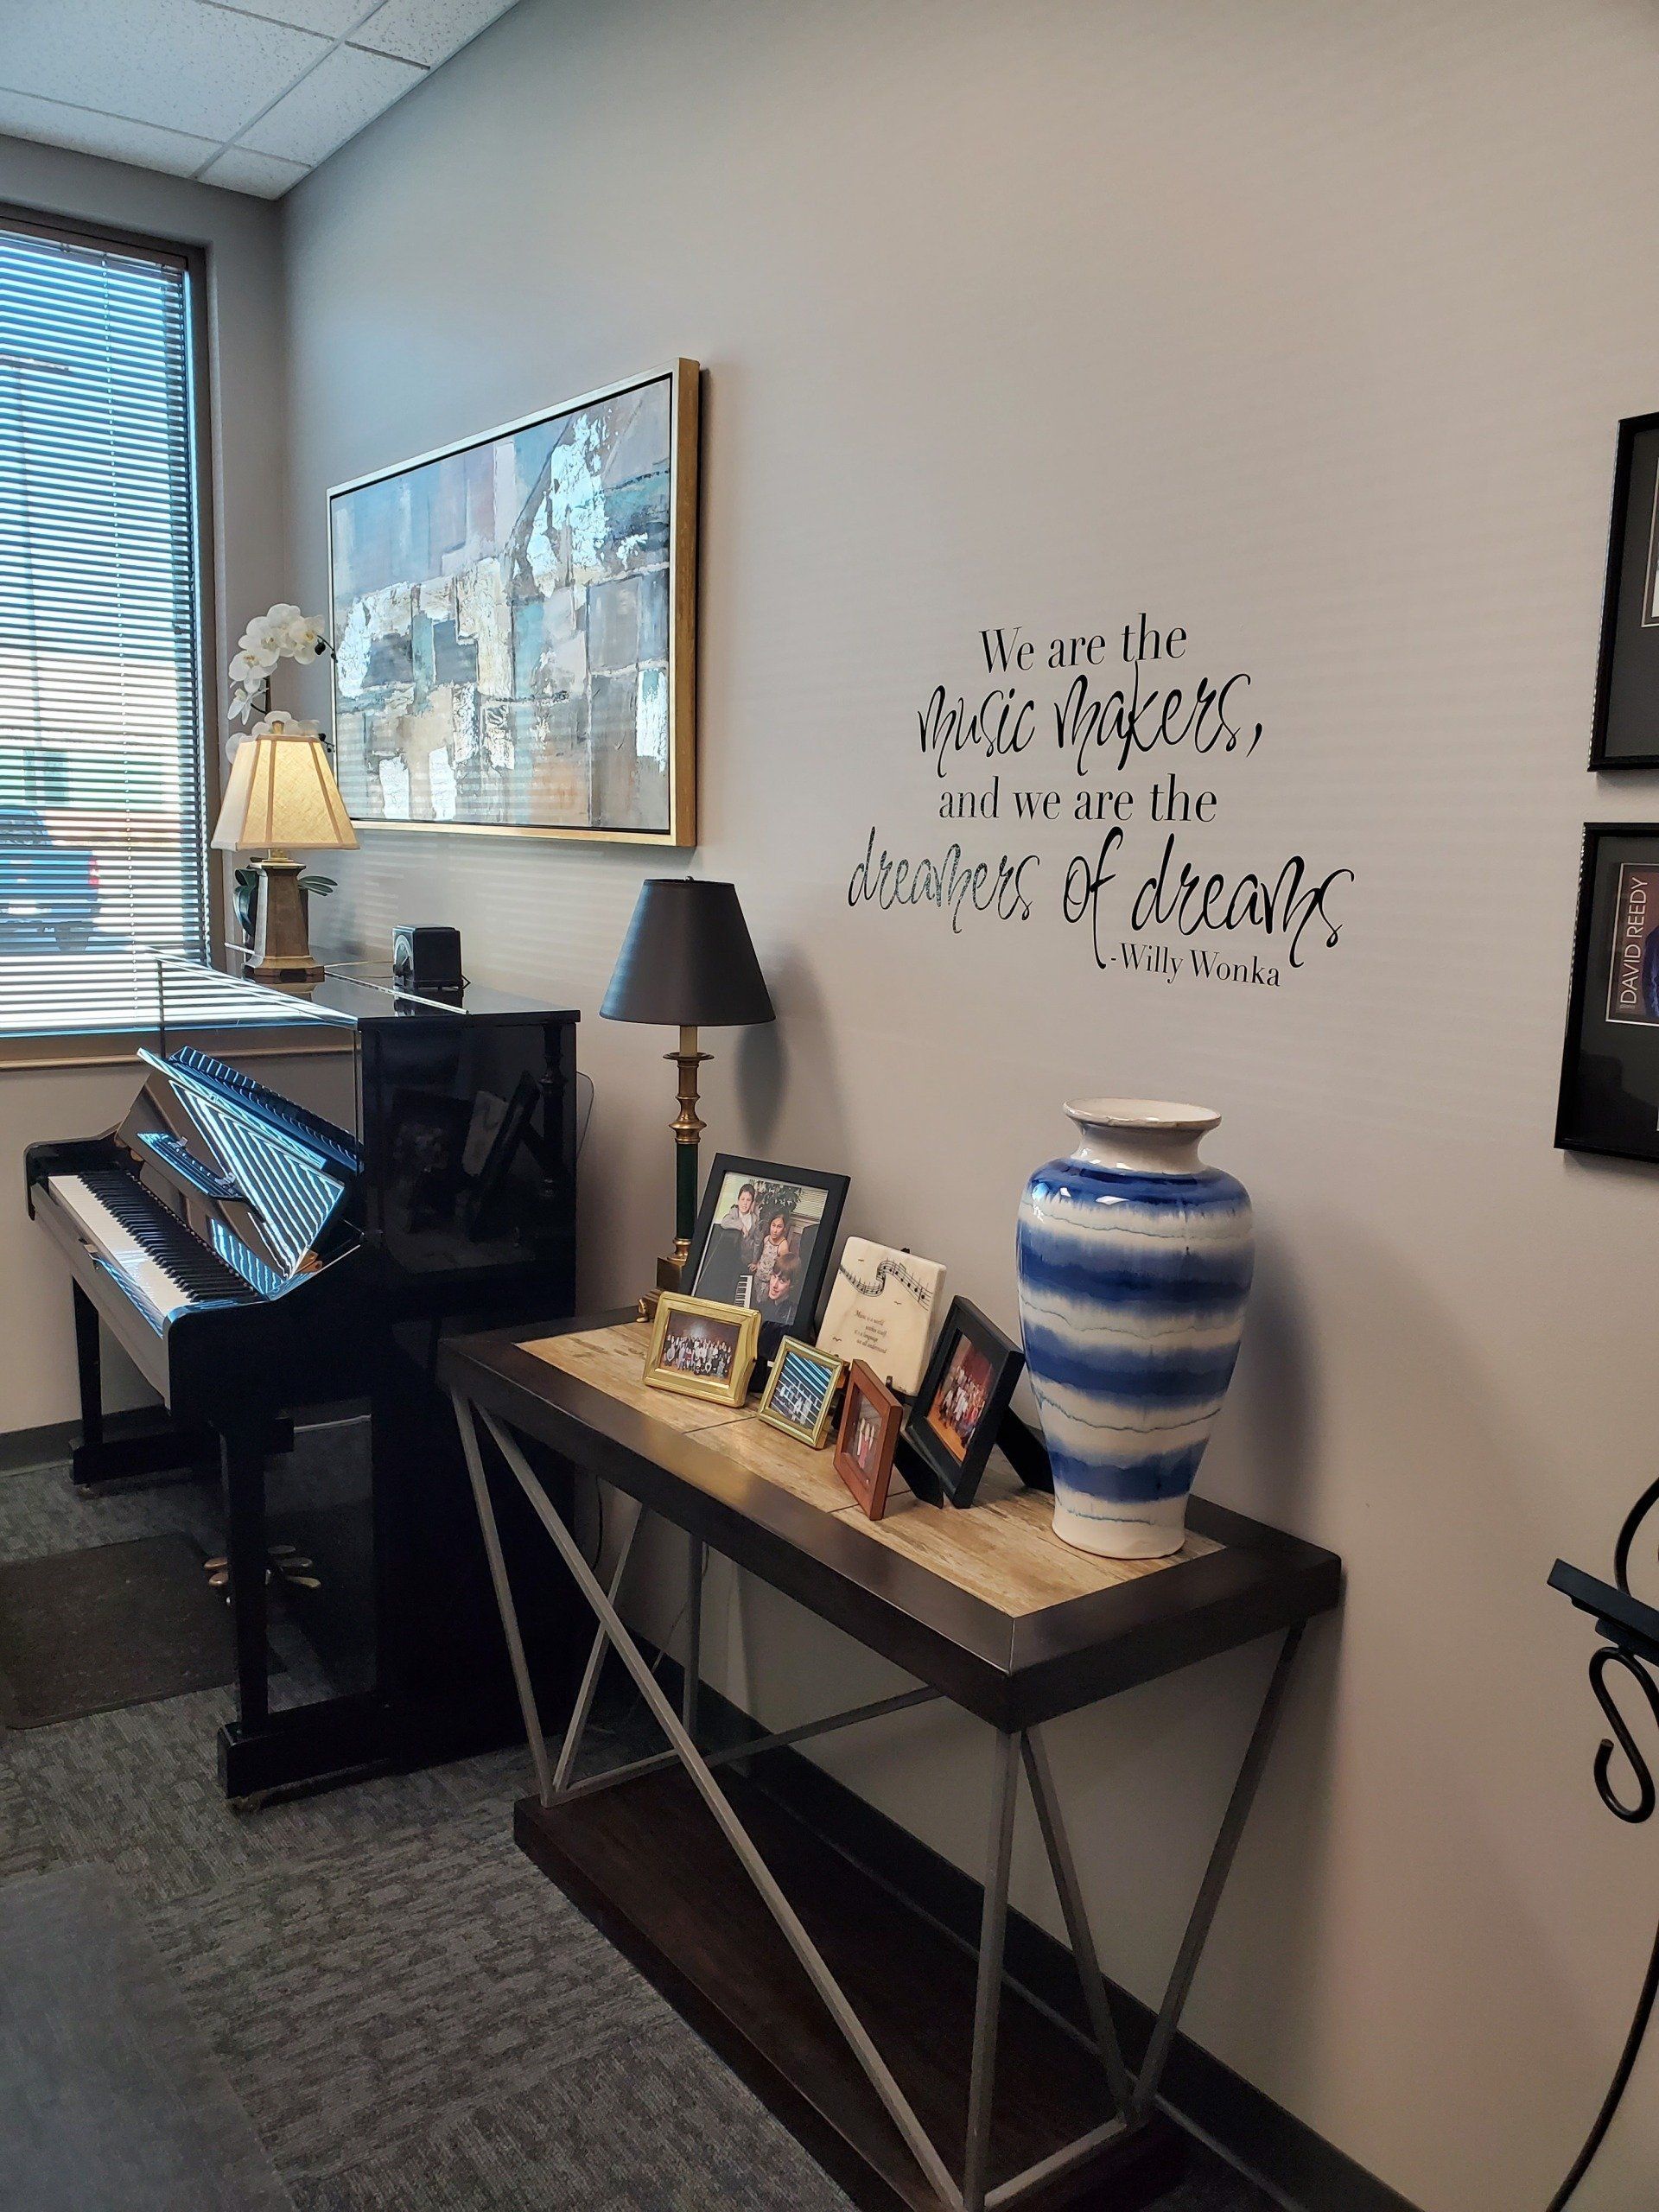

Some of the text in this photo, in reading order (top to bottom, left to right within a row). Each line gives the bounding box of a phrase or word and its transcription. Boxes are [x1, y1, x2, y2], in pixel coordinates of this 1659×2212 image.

[978, 613, 1187, 674] We are the
[917, 660, 1263, 778] music makers,
[938, 773, 1217, 823] and we are the
[848, 826, 1355, 969] dreamers of dreams
[1626, 876, 1649, 938] REEDY
[1110, 942, 1281, 987] -Willy Wonka
[1619, 943, 1643, 1005] DAVID
